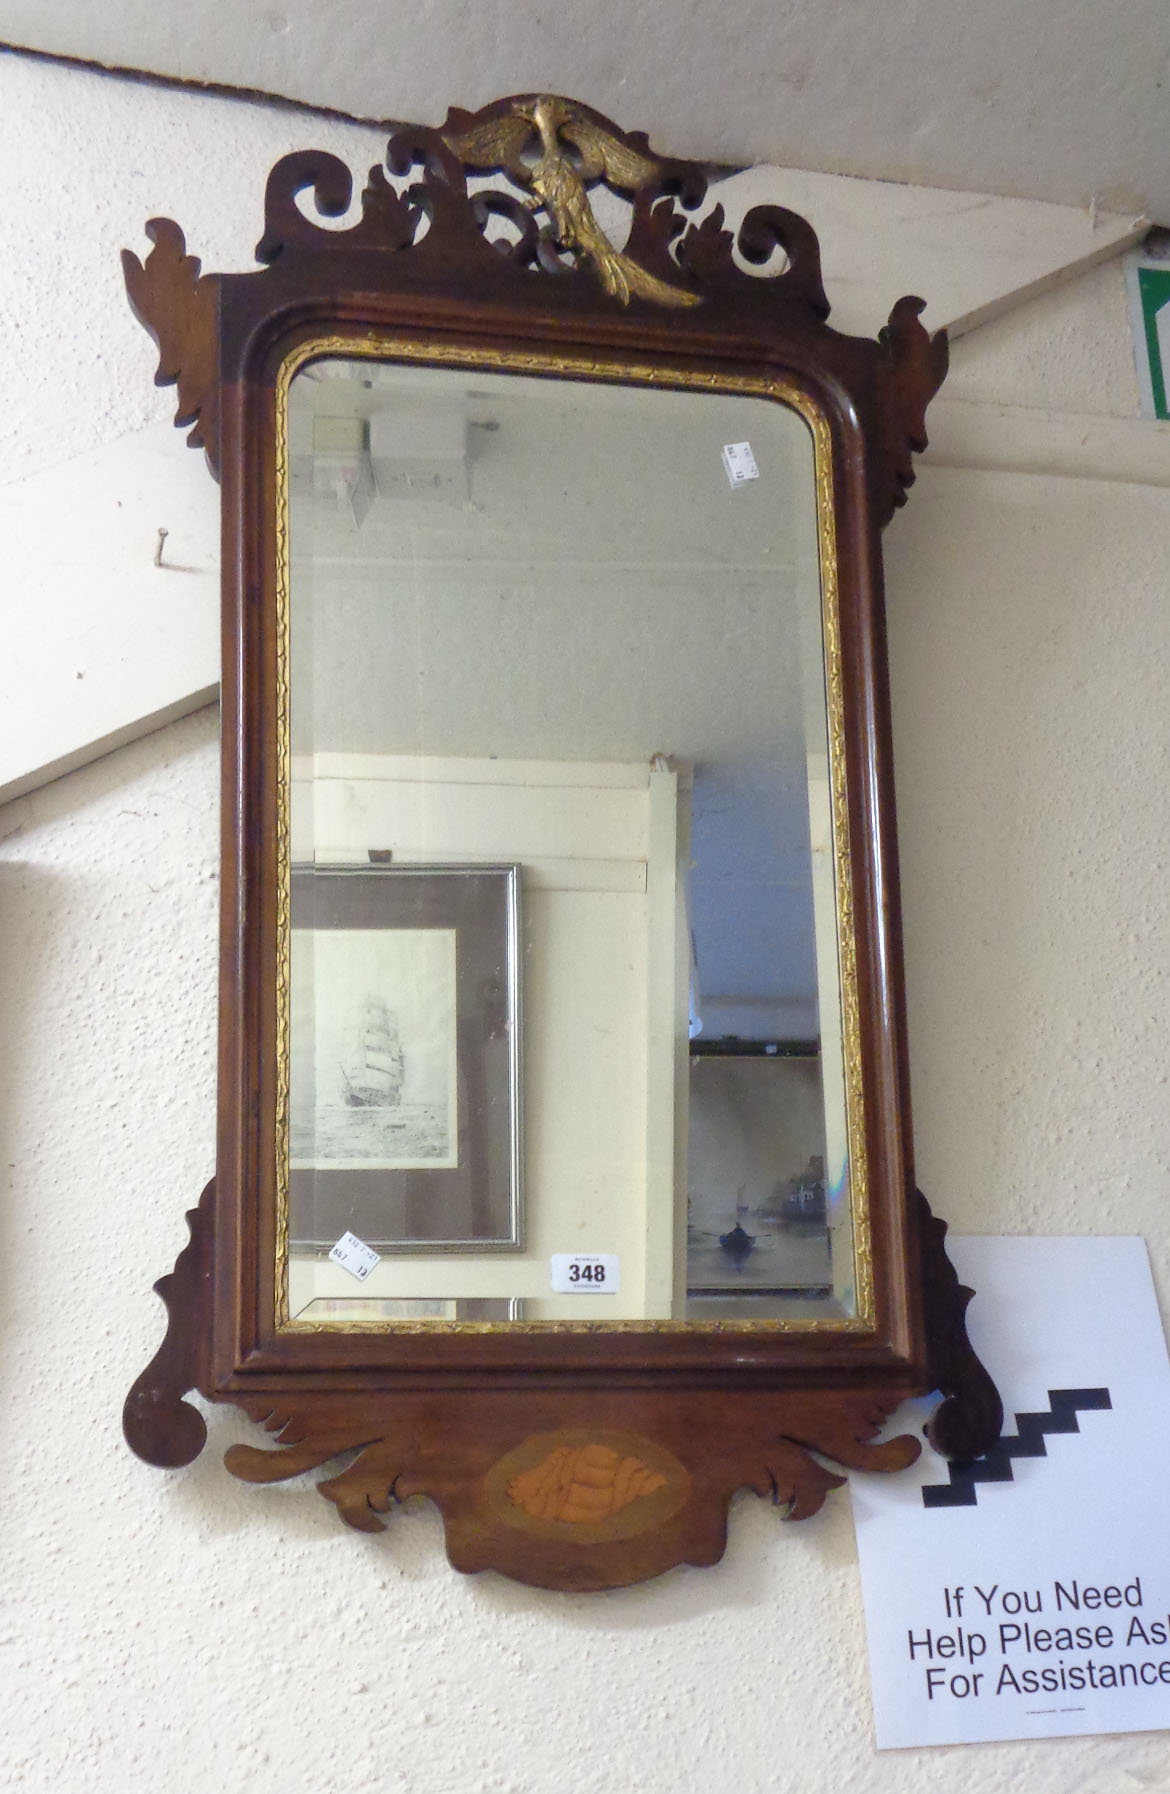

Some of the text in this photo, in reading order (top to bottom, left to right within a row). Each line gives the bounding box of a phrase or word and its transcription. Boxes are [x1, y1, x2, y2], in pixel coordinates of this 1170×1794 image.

[569, 1264, 605, 1282] 348
[944, 1576, 1143, 1618] If You Need
[908, 1614, 1170, 1664] Help Please As
[926, 1659, 1170, 1700] For Assistance
